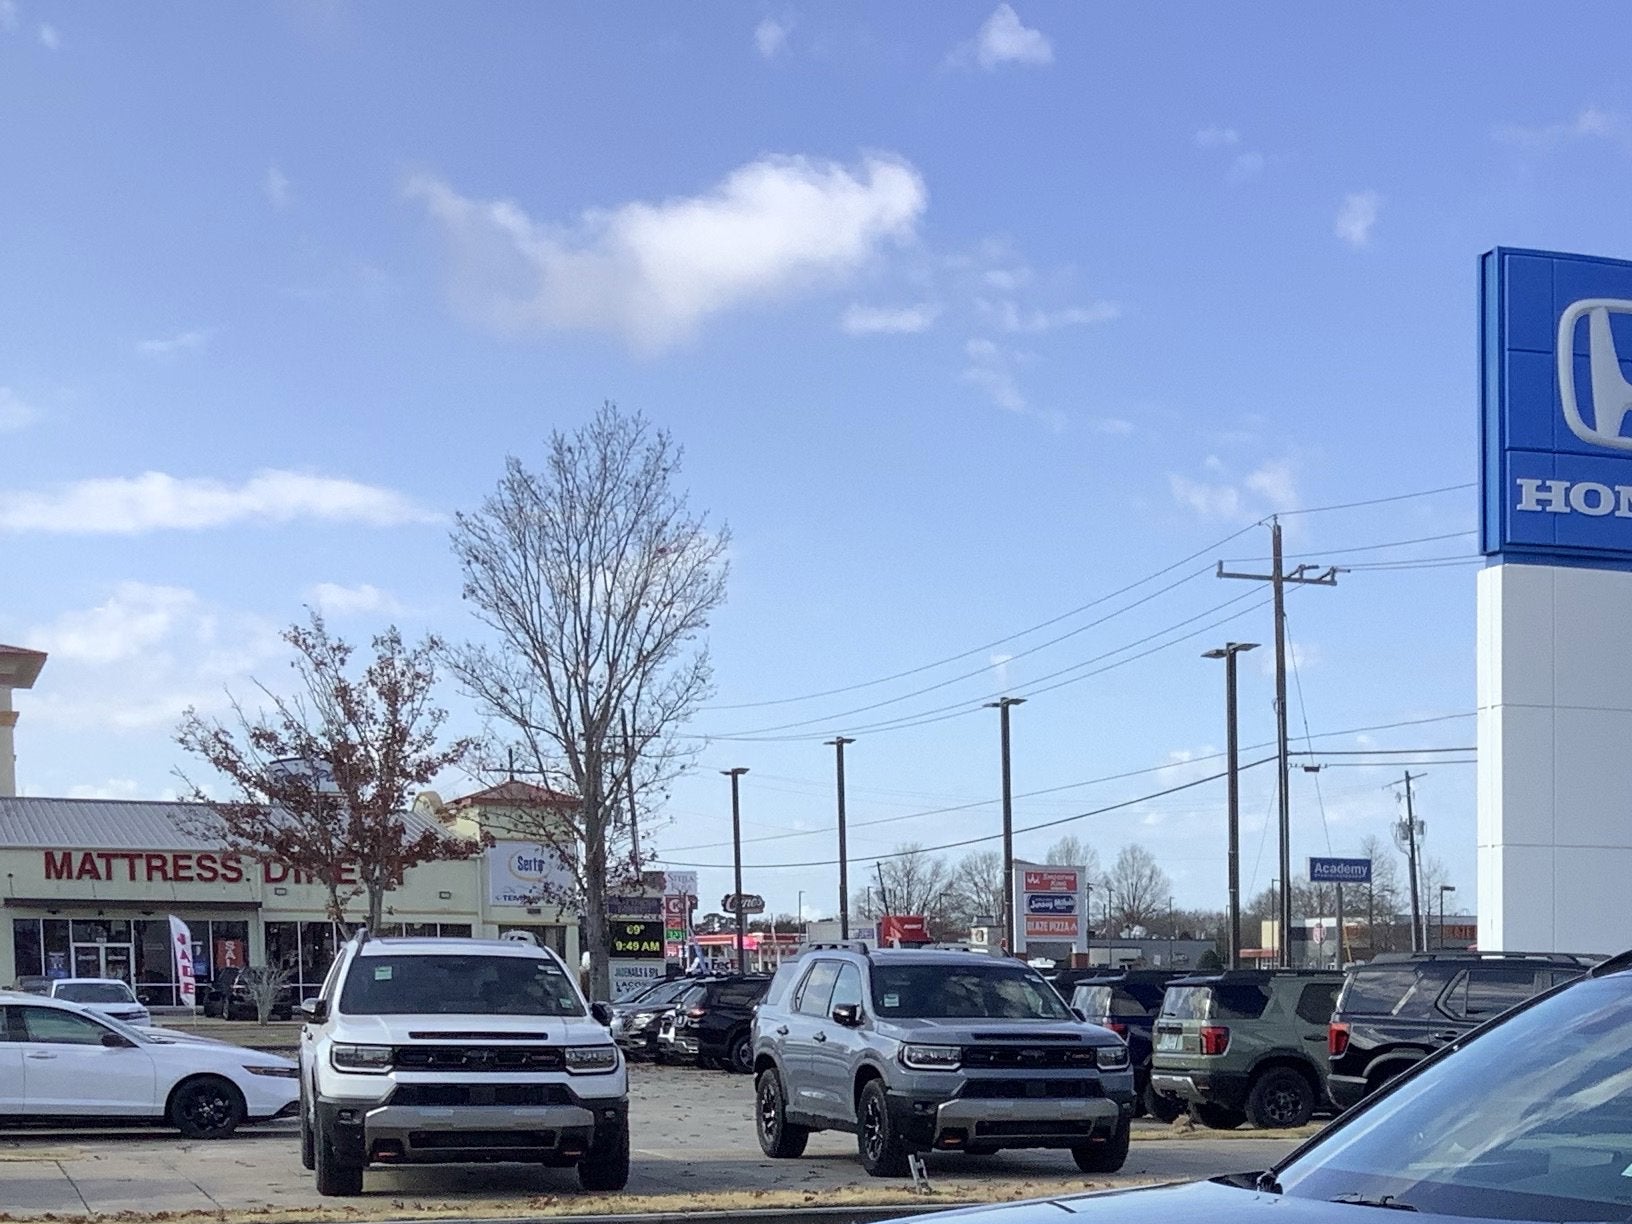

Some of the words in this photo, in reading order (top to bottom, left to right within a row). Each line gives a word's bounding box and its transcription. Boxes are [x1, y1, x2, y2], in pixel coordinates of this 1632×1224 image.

[44, 851, 244, 883] MATTRESS
[1314, 862, 1368, 876] Academy
[1049, 921, 1070, 933] PIZZA
[641, 941, 660, 952] AM
